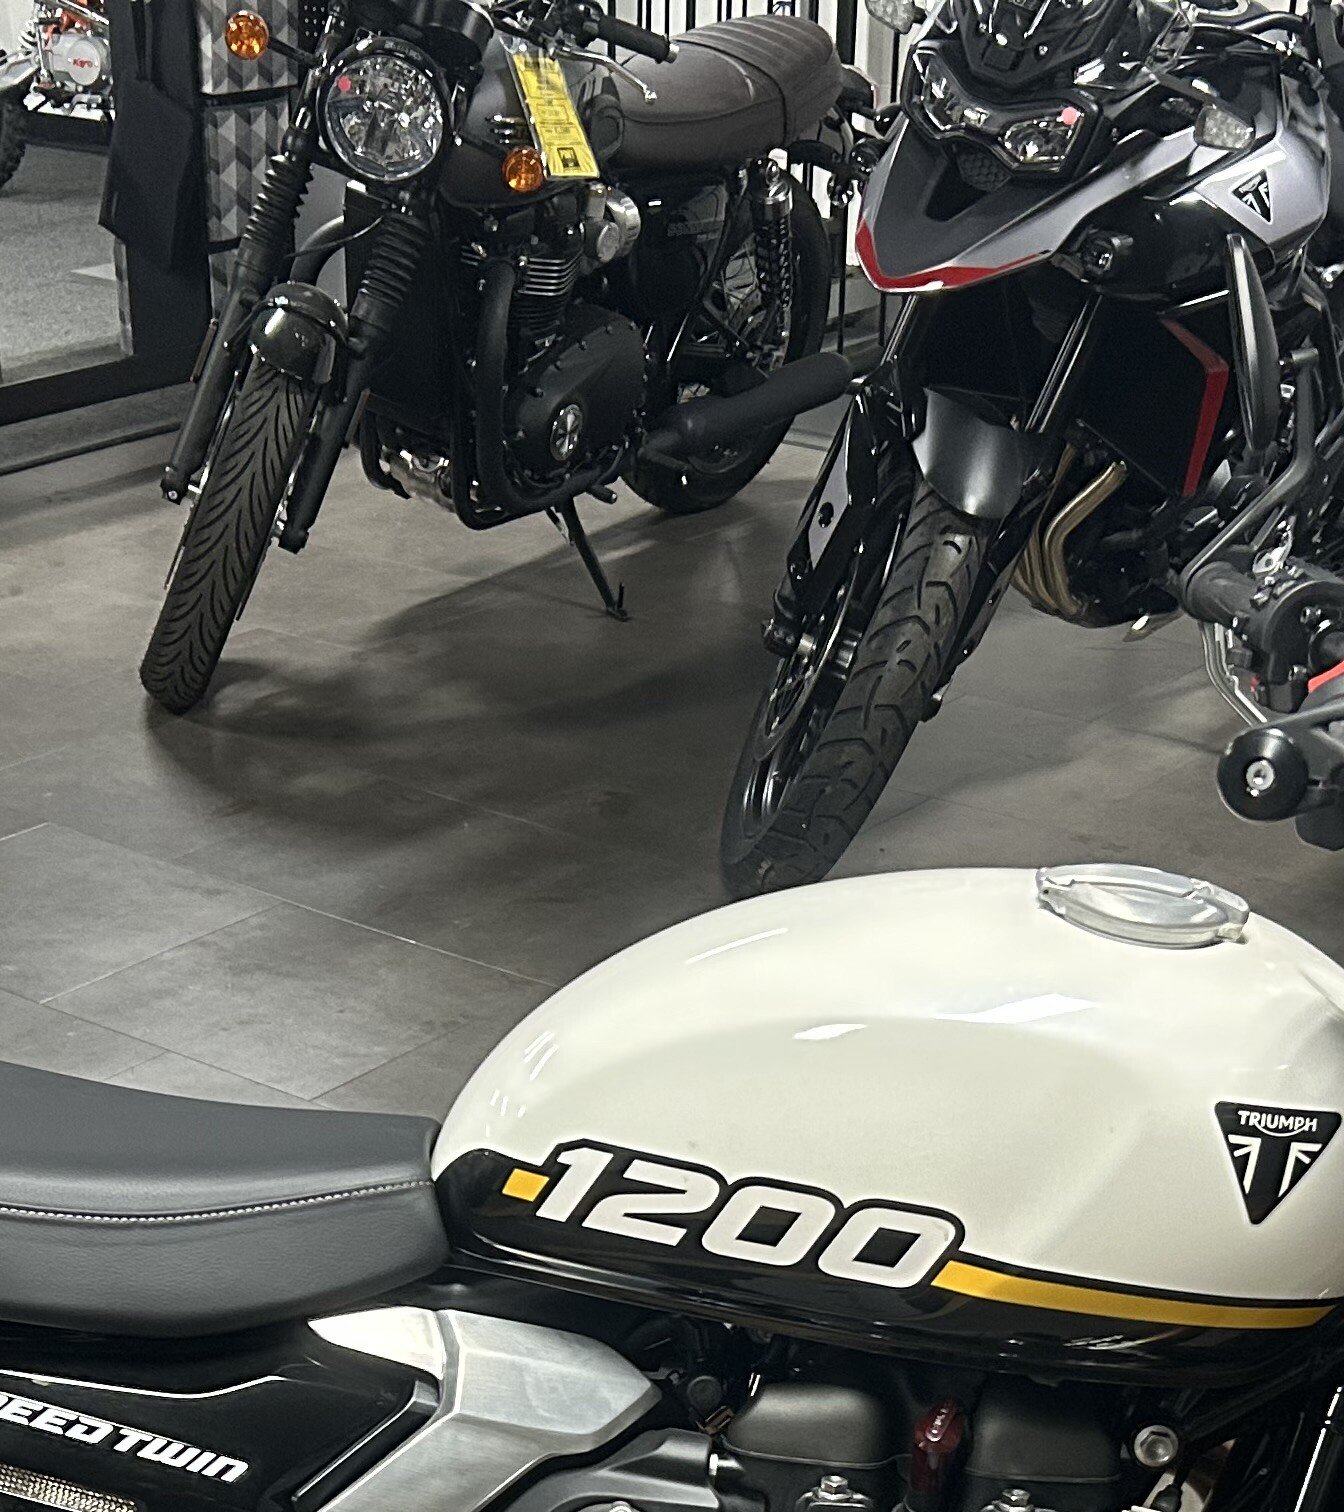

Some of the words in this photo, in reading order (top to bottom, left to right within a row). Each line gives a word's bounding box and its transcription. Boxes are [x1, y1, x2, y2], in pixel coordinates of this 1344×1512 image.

[1237, 1110, 1318, 1134] TRIUMPH
[535, 1146, 957, 1290] 1200
[112, 1428, 250, 1484] TWIN
